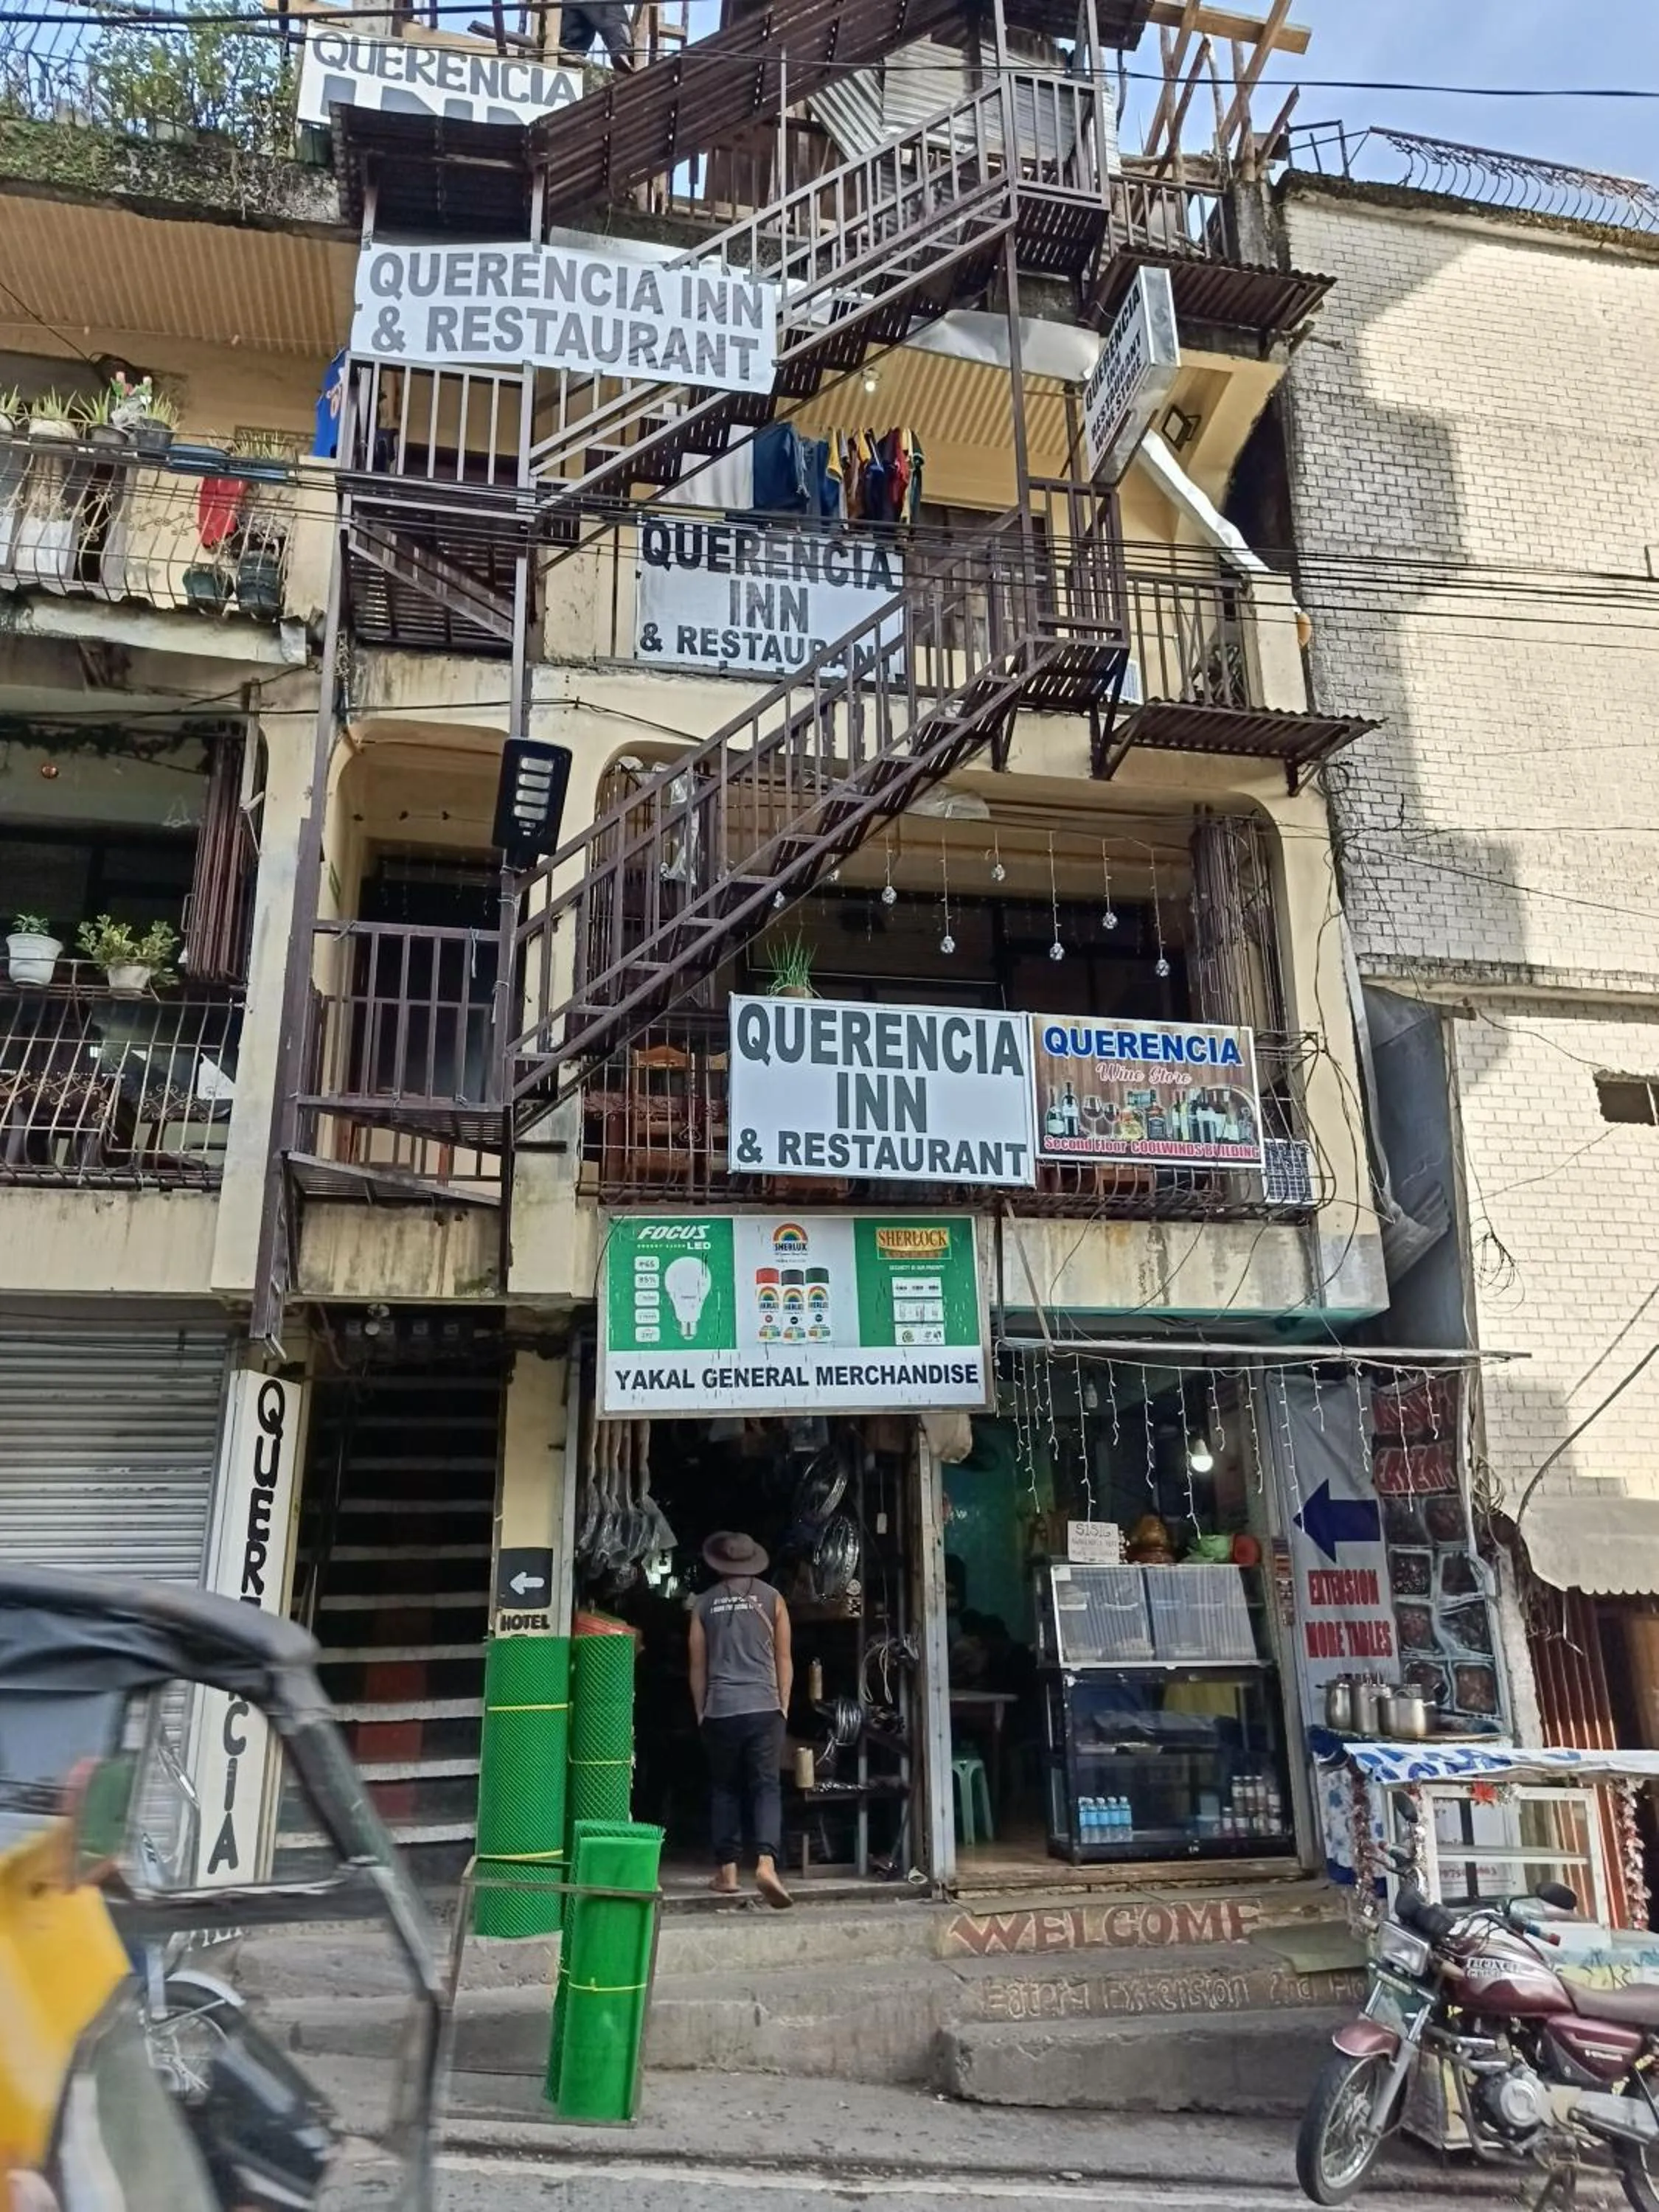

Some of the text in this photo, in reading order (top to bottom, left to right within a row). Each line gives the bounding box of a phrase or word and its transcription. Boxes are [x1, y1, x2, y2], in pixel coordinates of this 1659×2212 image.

[313, 32, 577, 106] QUERENCIA
[370, 251, 762, 330] QUERENCIA INN
[371, 305, 759, 381] & RESTAURANT
[643, 522, 894, 592] QUERENCIA
[729, 580, 808, 633] INN
[640, 622, 662, 653] &
[737, 1003, 1024, 1077] QUERENCIA
[1044, 1026, 1244, 1066] QUERENCIA
[1096, 1062, 1192, 1085] Wine Store
[837, 1071, 927, 1133] INN
[737, 1128, 1026, 1178] & RESTAURANT
[637, 1225, 710, 1239] FOCUS
[687, 1242, 711, 1250] LED
[878, 1230, 947, 1246] SHERLOCK
[615, 1363, 978, 1391] YAKAL GENERAL MERCHANDISE
[1307, 1569, 1380, 1605] EXTENSION
[206, 1379, 286, 1875] QUERCIA
[500, 1614, 551, 1631] HOTEL
[1305, 1621, 1393, 1658] MORE TABLES
[948, 1898, 1262, 1955] WELCOME
